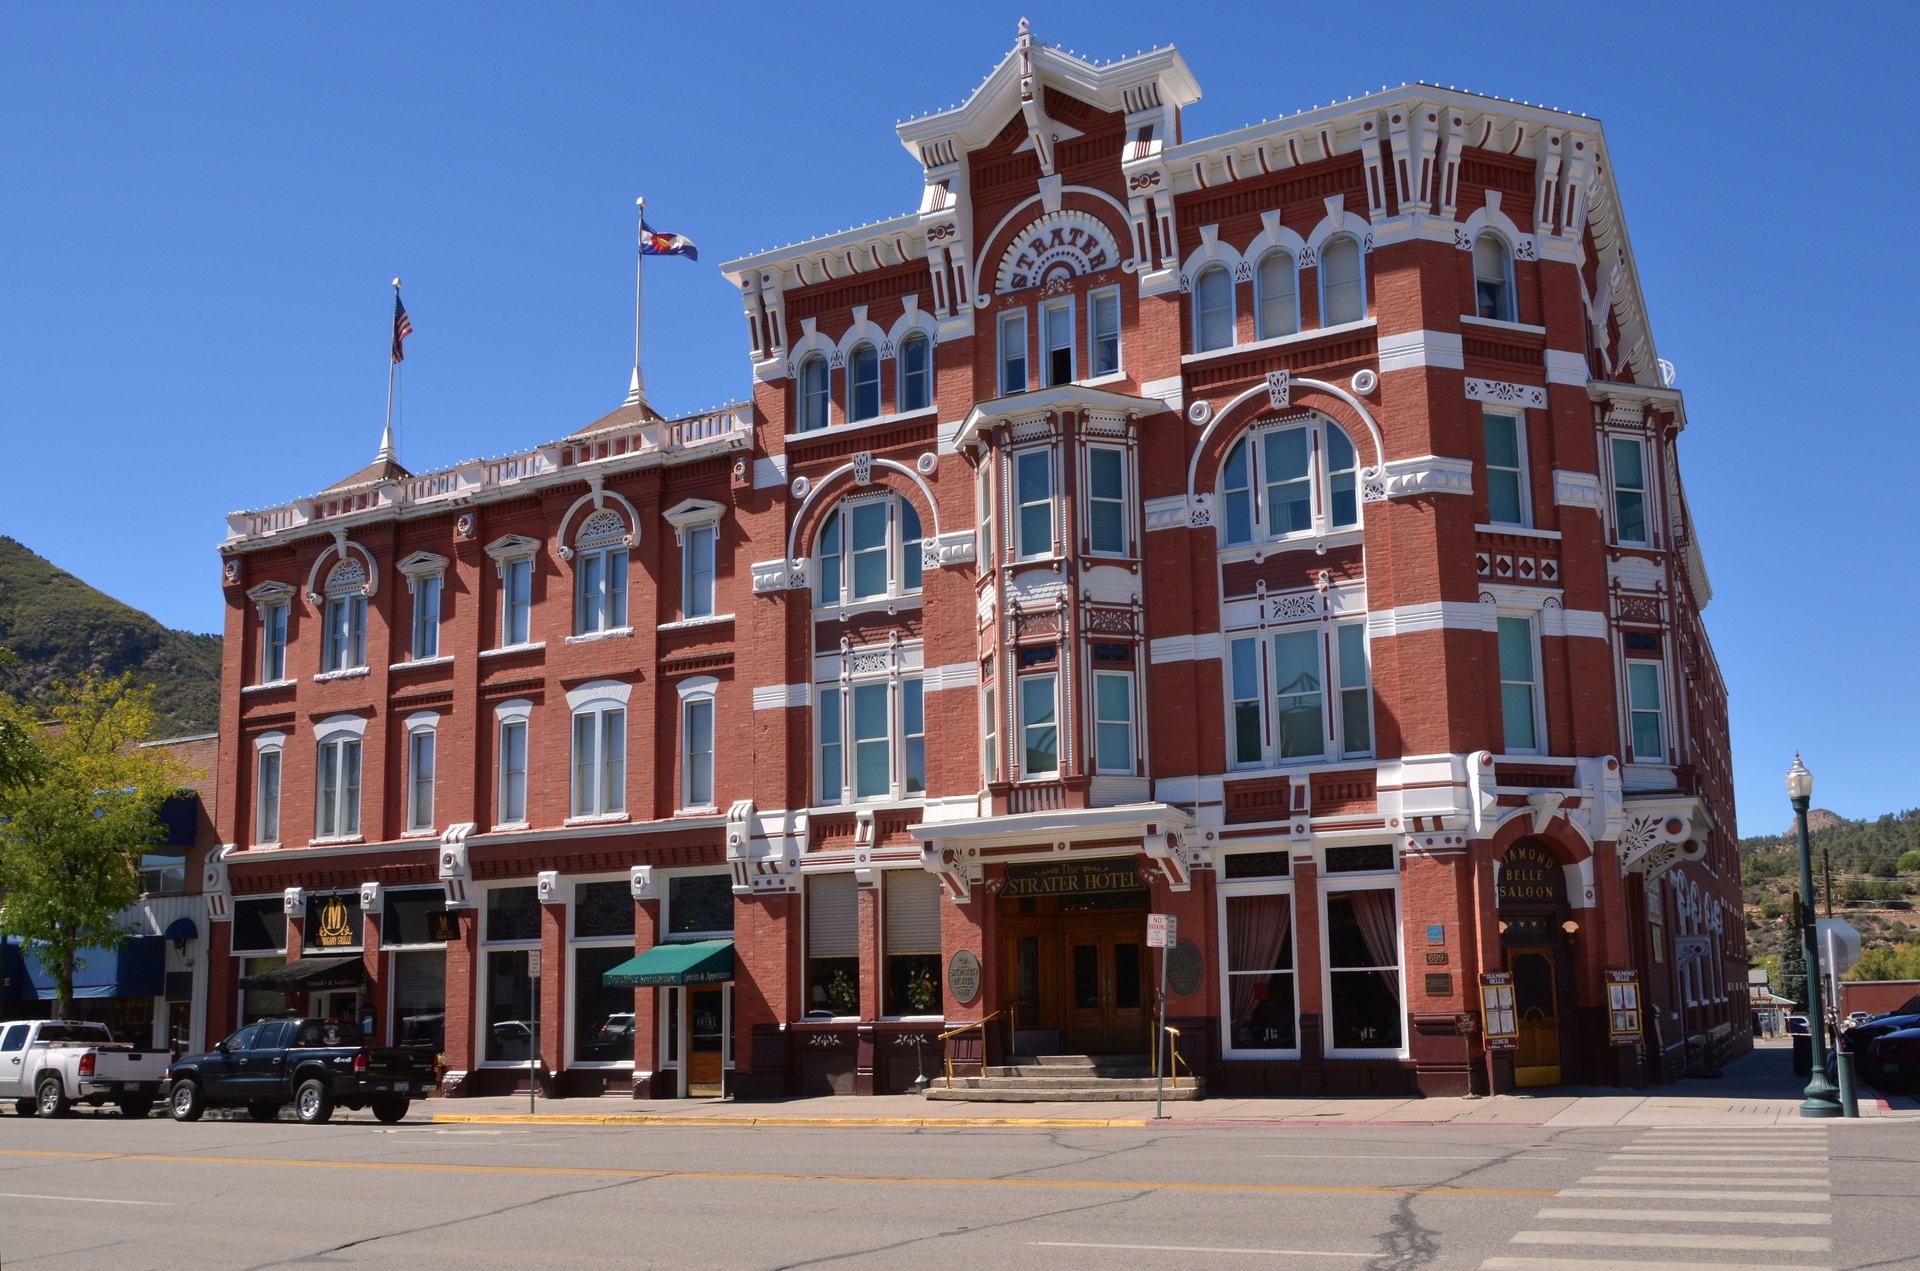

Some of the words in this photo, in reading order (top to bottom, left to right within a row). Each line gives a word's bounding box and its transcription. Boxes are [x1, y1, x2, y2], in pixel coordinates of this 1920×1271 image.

[1011, 227, 1107, 289] STRATER
[1501, 847, 1553, 869] IAMOND
[1062, 864, 1078, 875] The
[1506, 869, 1543, 881] BELLE
[1009, 874, 1079, 894] STRATER
[1085, 871, 1140, 890] HOTEL
[1500, 886, 1553, 898] SALOON
[1428, 953, 1444, 962] 699
